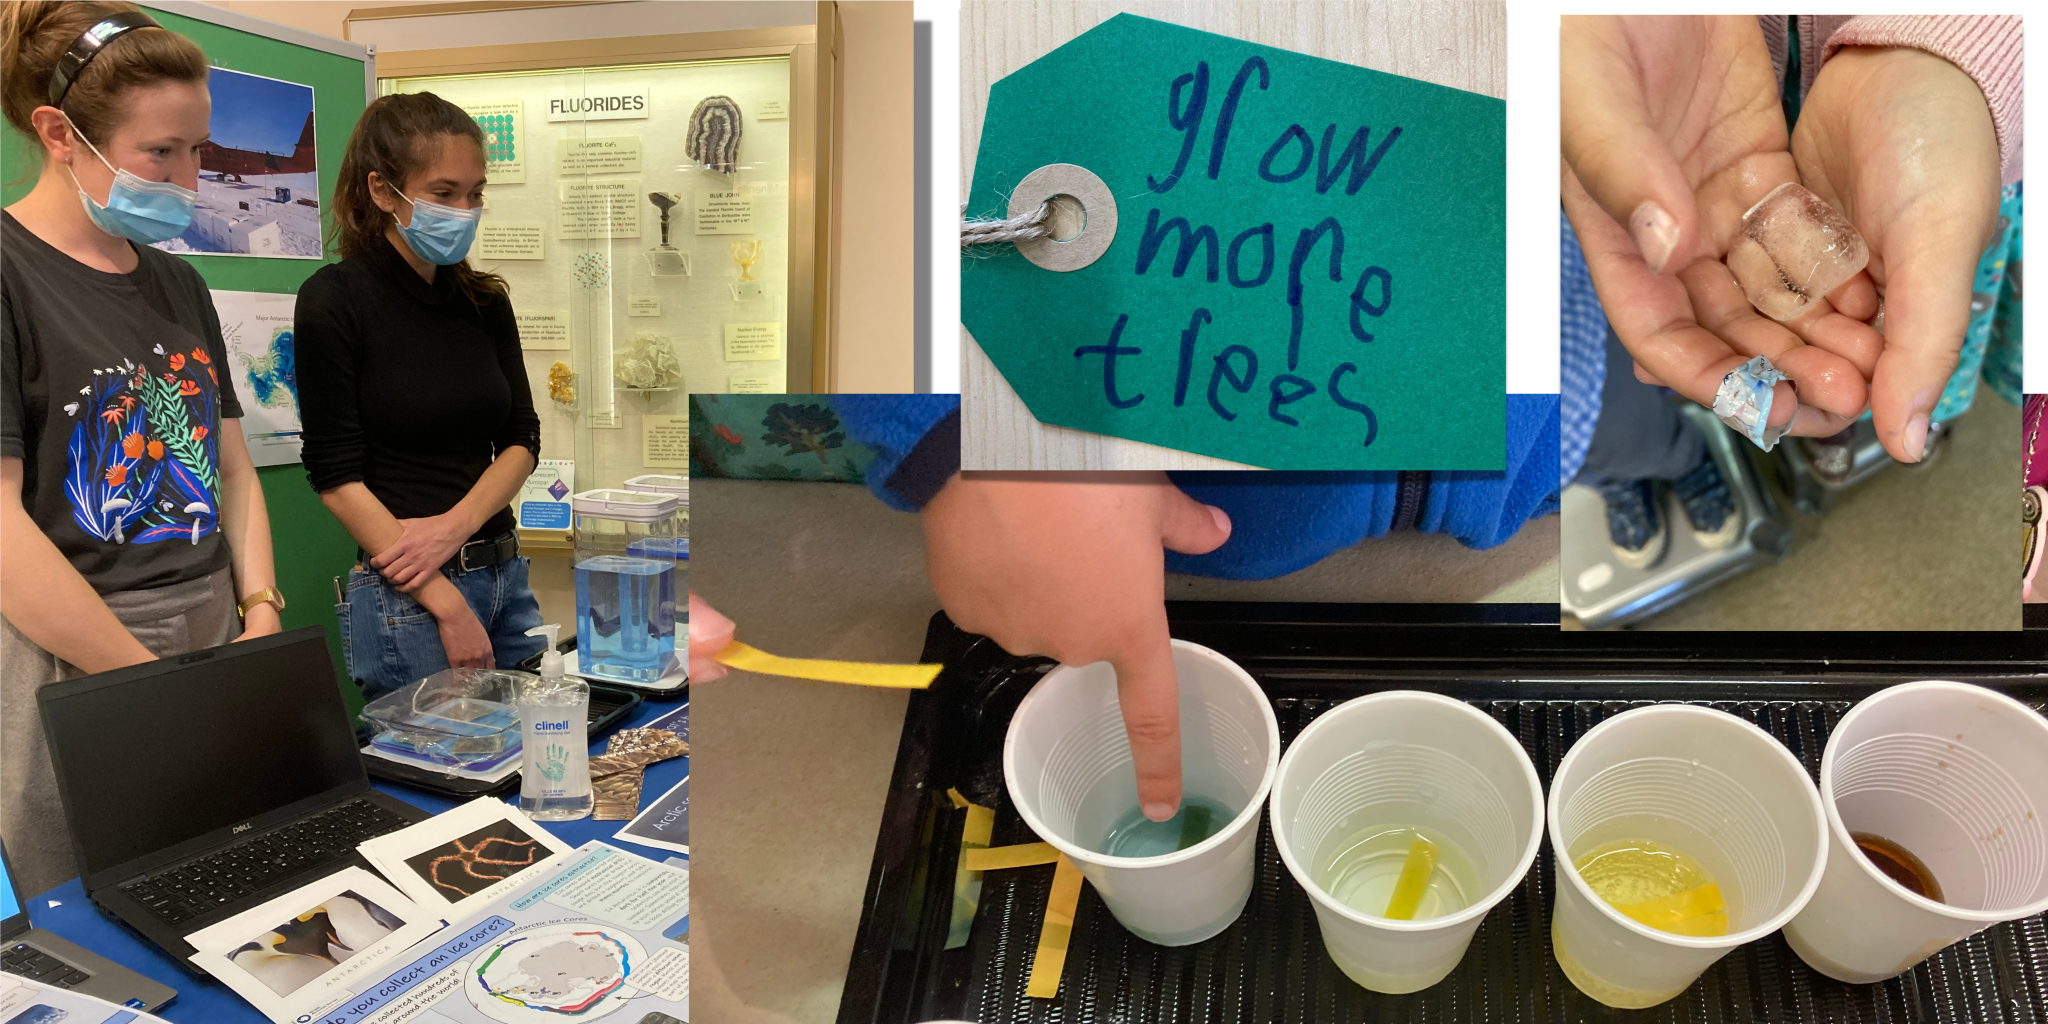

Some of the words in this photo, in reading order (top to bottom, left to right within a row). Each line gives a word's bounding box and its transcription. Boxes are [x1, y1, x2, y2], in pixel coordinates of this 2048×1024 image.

[550, 95, 644, 114] FLUORIDES
[1147, 56, 1403, 195] grow
[1135, 207, 1392, 371] more
[255, 314, 269, 322] Major
[535, 721, 569, 731] clinell
[232, 822, 252, 834] DELL
[652, 805, 687, 831] Arctic
[487, 870, 541, 899] ANTARCTICA
[509, 921, 547, 935] Antarctic
[325, 945, 392, 987] ANTARCTICA
[347, 994, 379, 1017] you
[379, 966, 426, 997] collect
[429, 954, 449, 968] an
[448, 941, 469, 955] ice
[469, 919, 505, 943] core?
[377, 997, 413, 1022] collected
[411, 976, 450, 1000] hundreds
